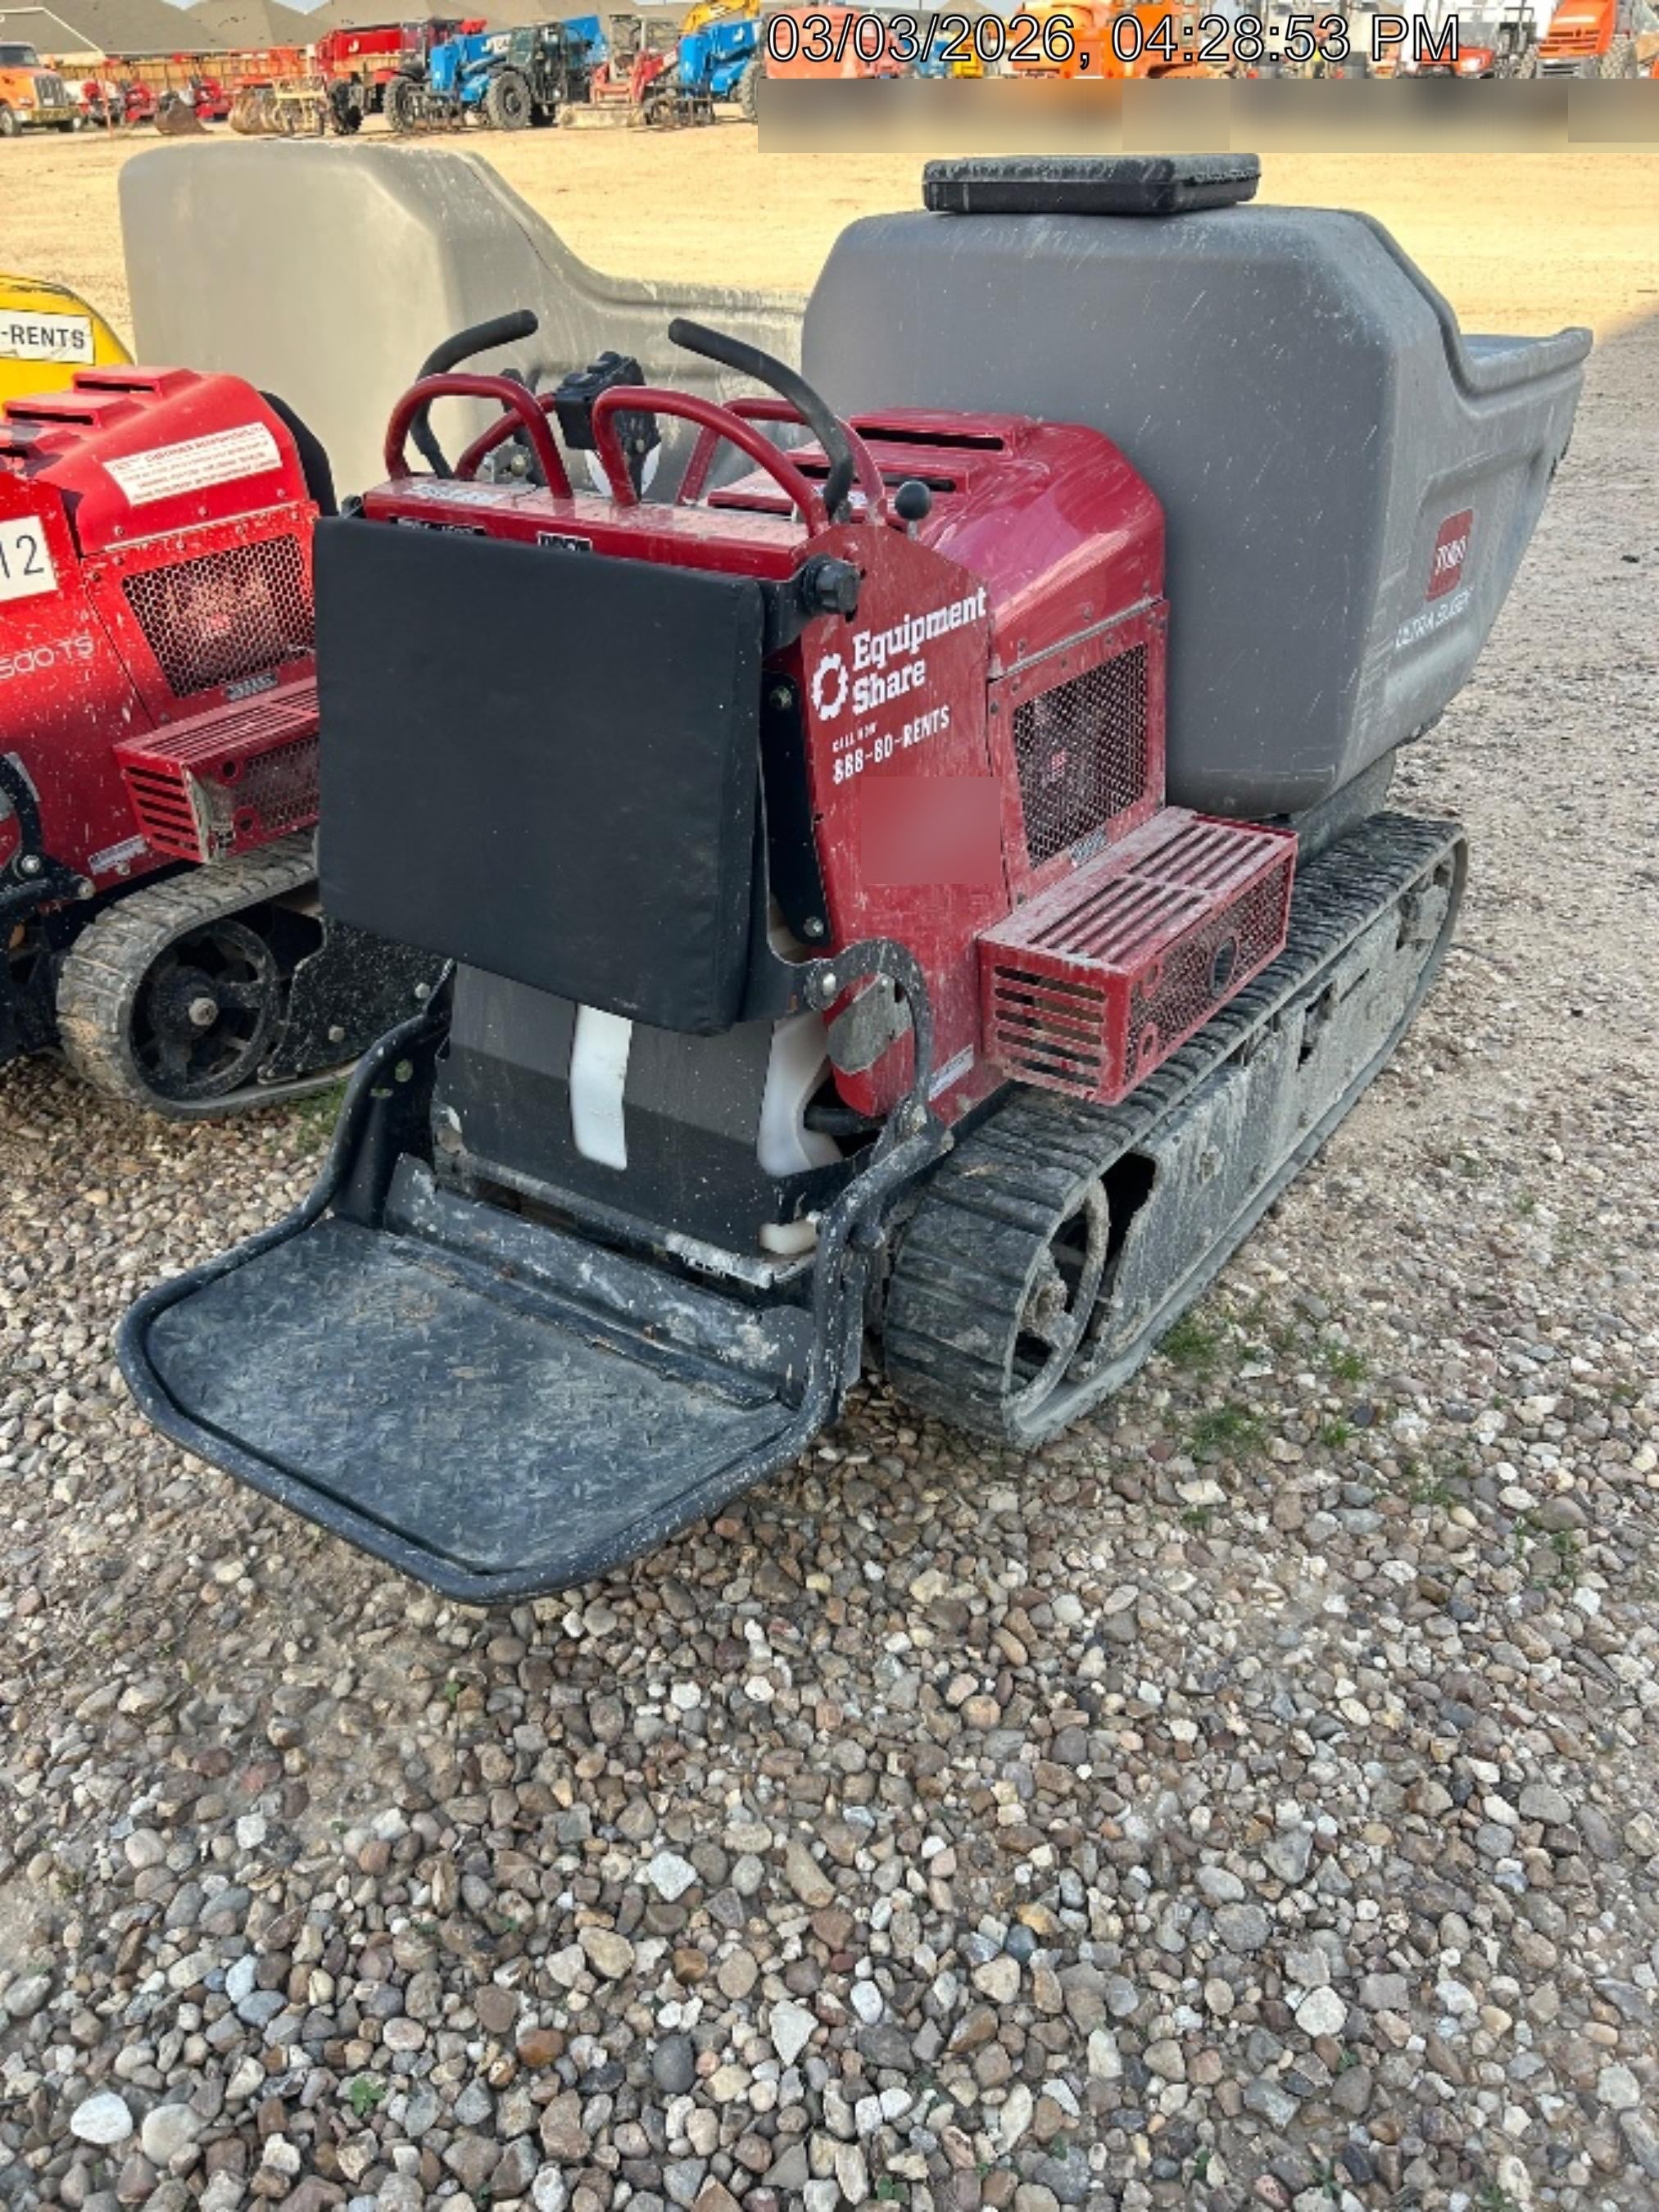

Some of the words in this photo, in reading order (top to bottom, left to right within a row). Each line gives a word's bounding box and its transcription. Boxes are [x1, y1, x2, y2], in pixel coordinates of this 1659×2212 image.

[1, 324, 84, 349] -RENTS
[853, 587, 986, 672] Equipment
[852, 659, 926, 715] Share
[832, 705, 950, 785] 888-80-RENTS
